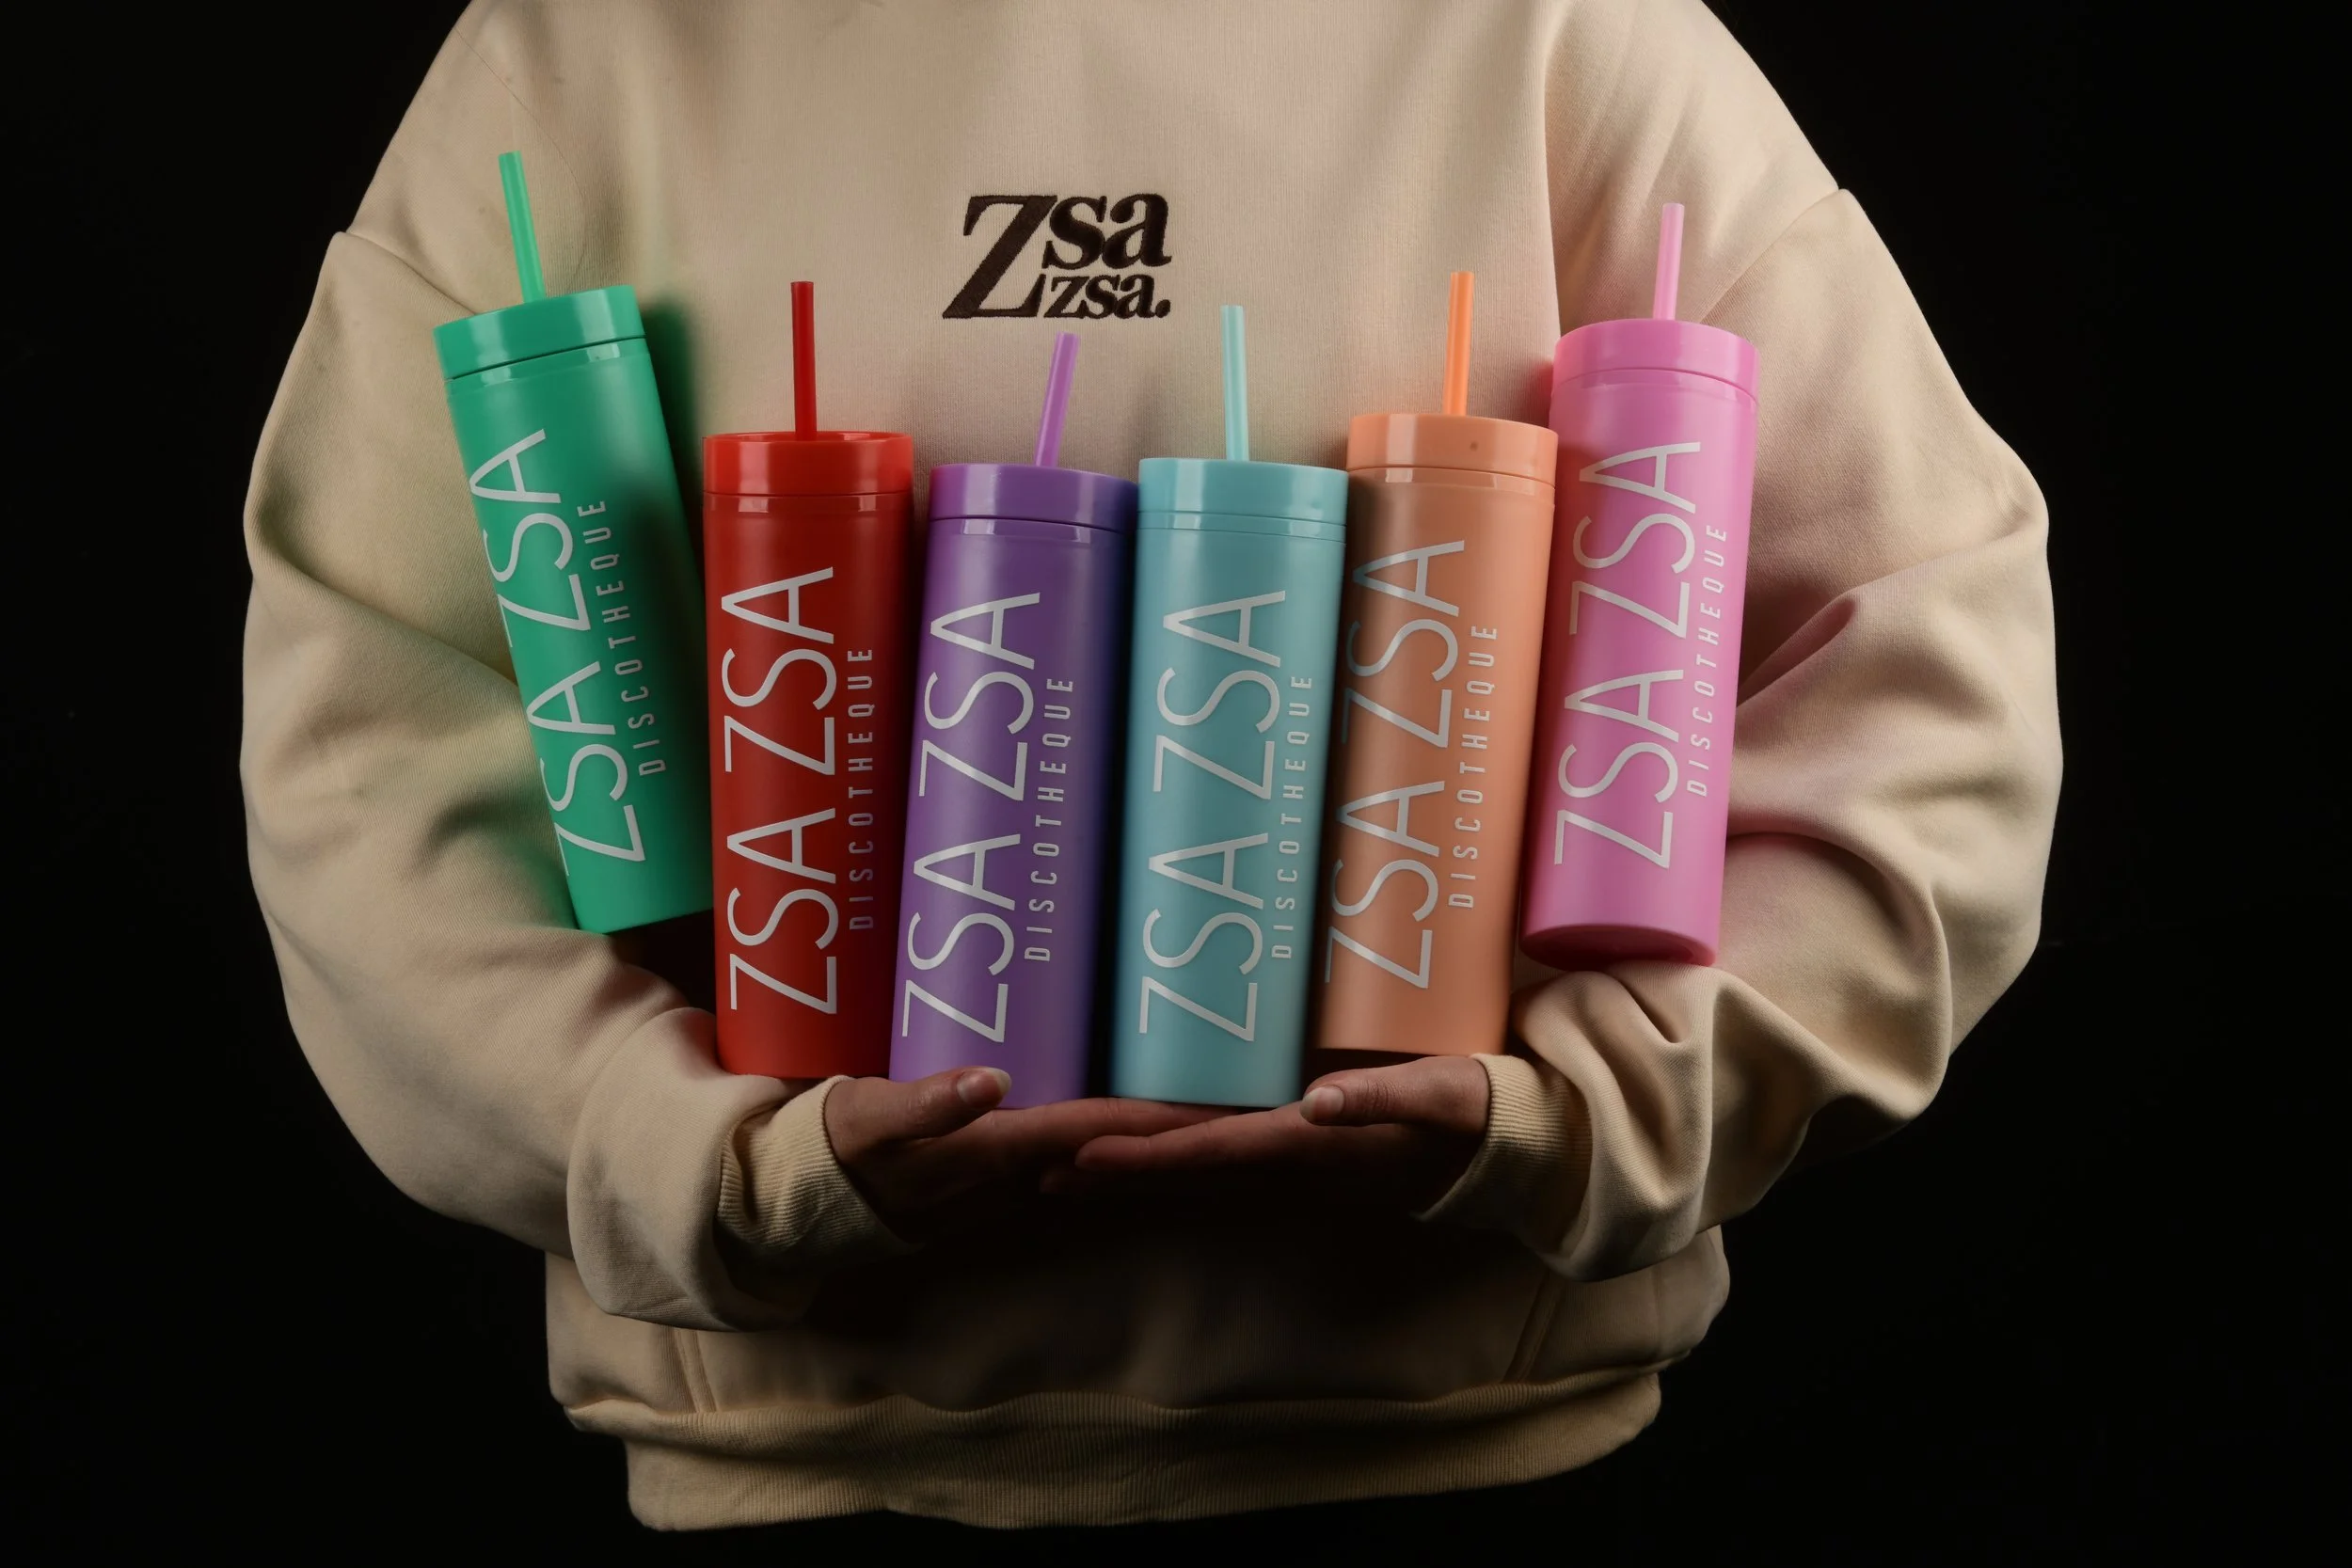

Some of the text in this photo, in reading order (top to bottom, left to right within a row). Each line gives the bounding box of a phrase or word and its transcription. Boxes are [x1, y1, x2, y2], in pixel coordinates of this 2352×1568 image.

[942, 193, 1172, 319] Zsa
[1043, 274, 1171, 319] zsa.
[469, 428, 646, 877] ZSA ZSA
[577, 499, 666, 776] DISCOTHEQUE
[1324, 539, 1465, 990] ZSA ZSA
[1448, 625, 1498, 910] DISCOTHEQUE
[1554, 441, 1701, 869] ZSA ZSA
[1687, 524, 1727, 798] DISCOTHEQUE
[721, 566, 839, 1015] ZSA ZSA
[848, 648, 874, 930] DISCOTHEQUE
[902, 592, 1041, 1043] ZSA ZSA
[1024, 677, 1073, 962] DISCOTHEQUE
[1139, 590, 1286, 1042] ZSA ZSA
[1271, 675, 1312, 959] DISCOTHEQUE
